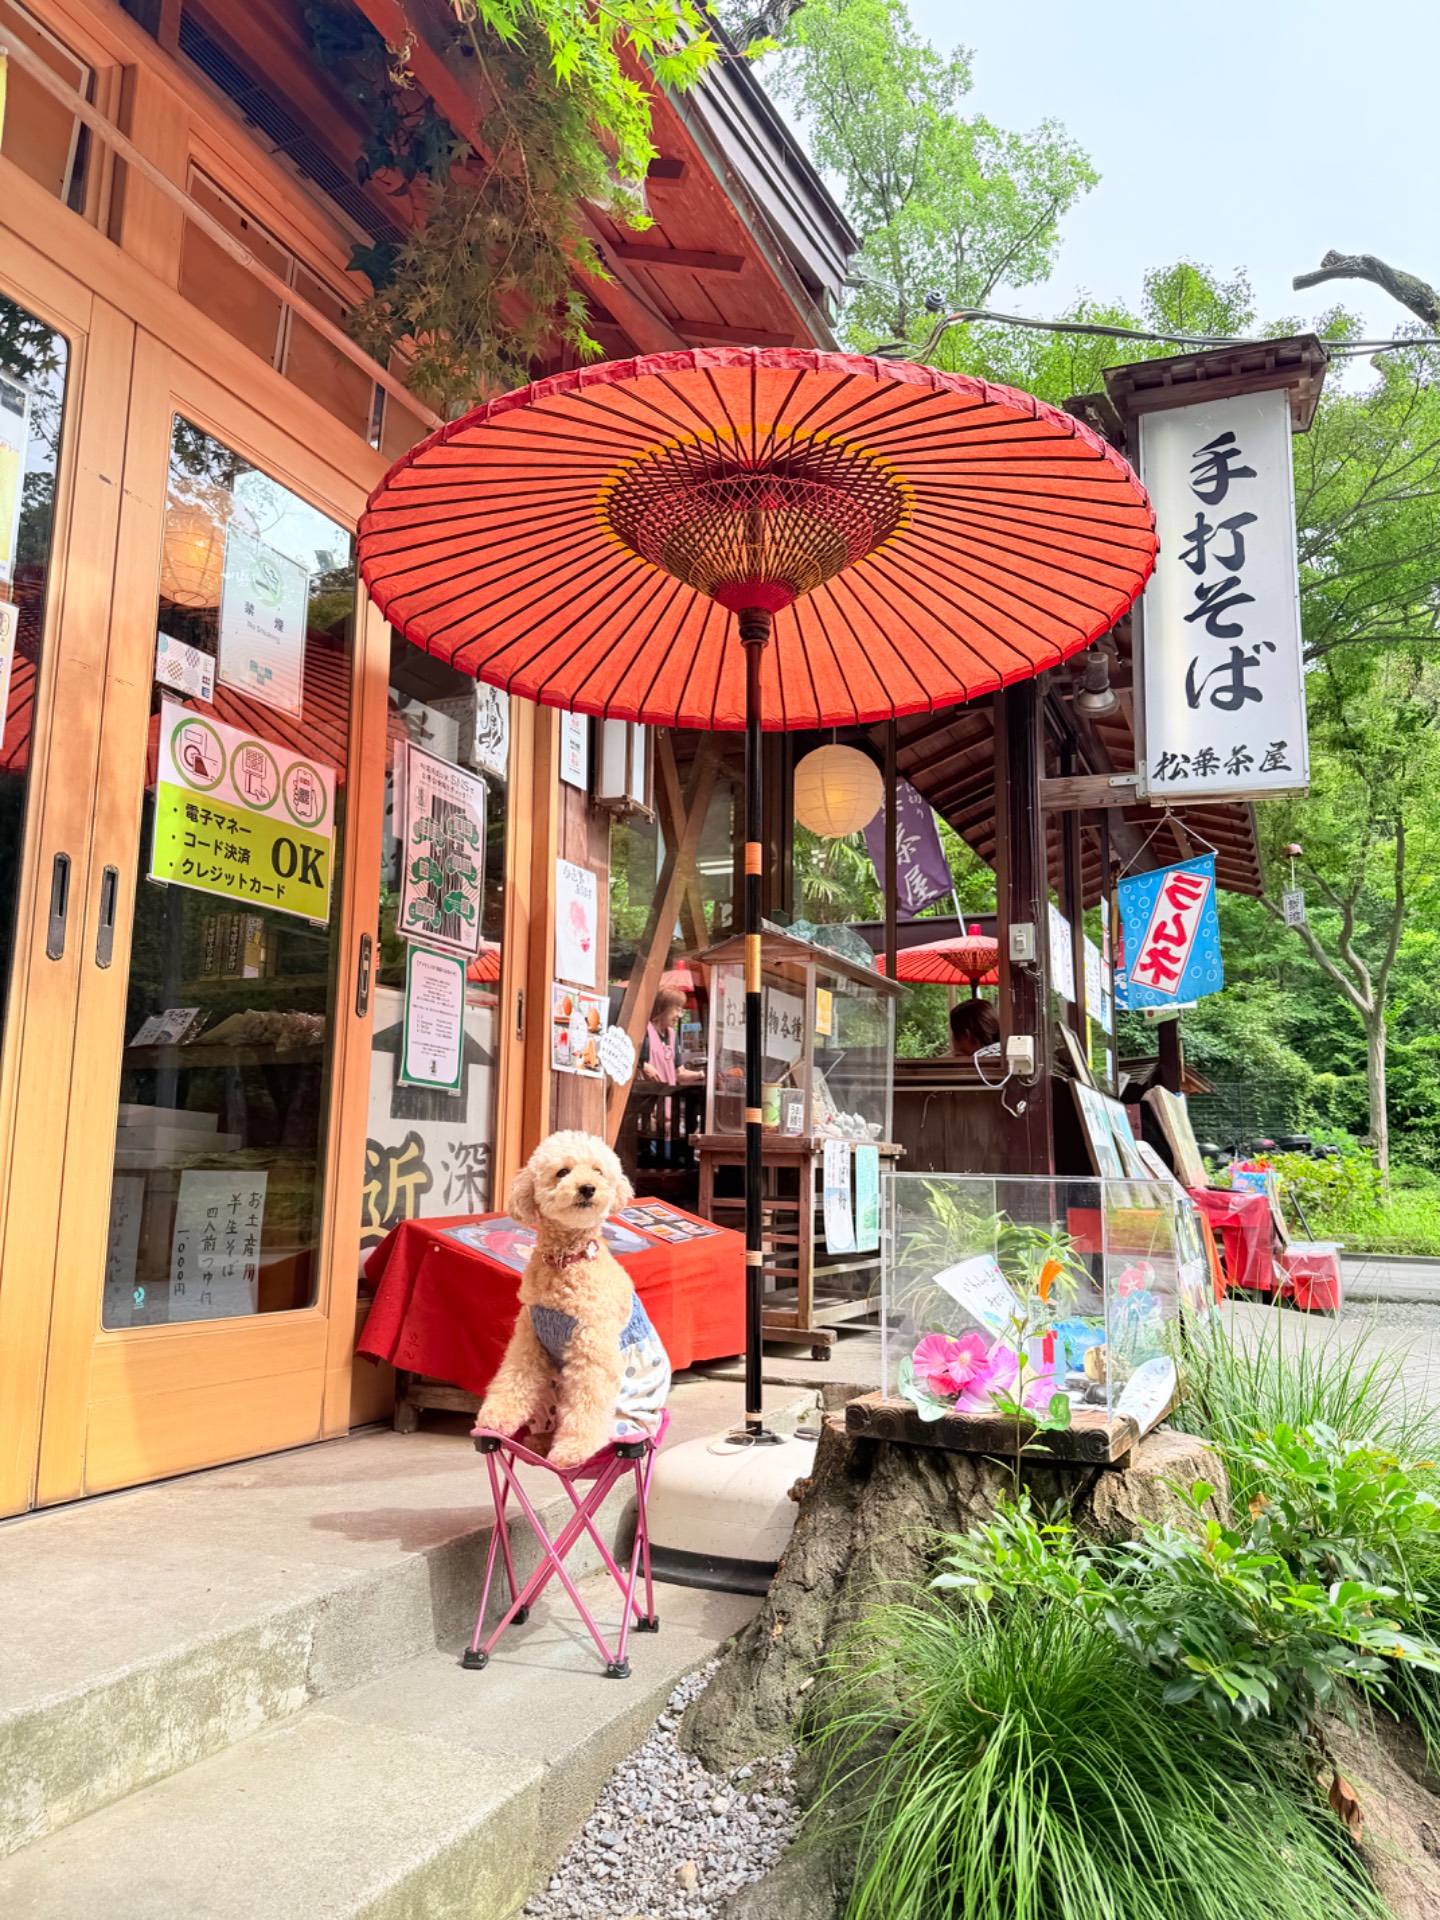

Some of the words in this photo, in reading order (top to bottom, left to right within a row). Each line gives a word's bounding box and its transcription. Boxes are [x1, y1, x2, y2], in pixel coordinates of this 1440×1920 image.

[1178, 430, 1277, 711] 手打そば
[1151, 740, 1293, 782] 松葉茶屋
[185, 803, 252, 835] 電子マネー
[184, 831, 251, 866] コード決済
[271, 837, 325, 889] OK
[182, 858, 286, 900] クレジットカード
[1139, 875, 1204, 985] ラムネ
[222, 1193, 242, 1278] 半生そば
[242, 1192, 263, 1282] お土産用
